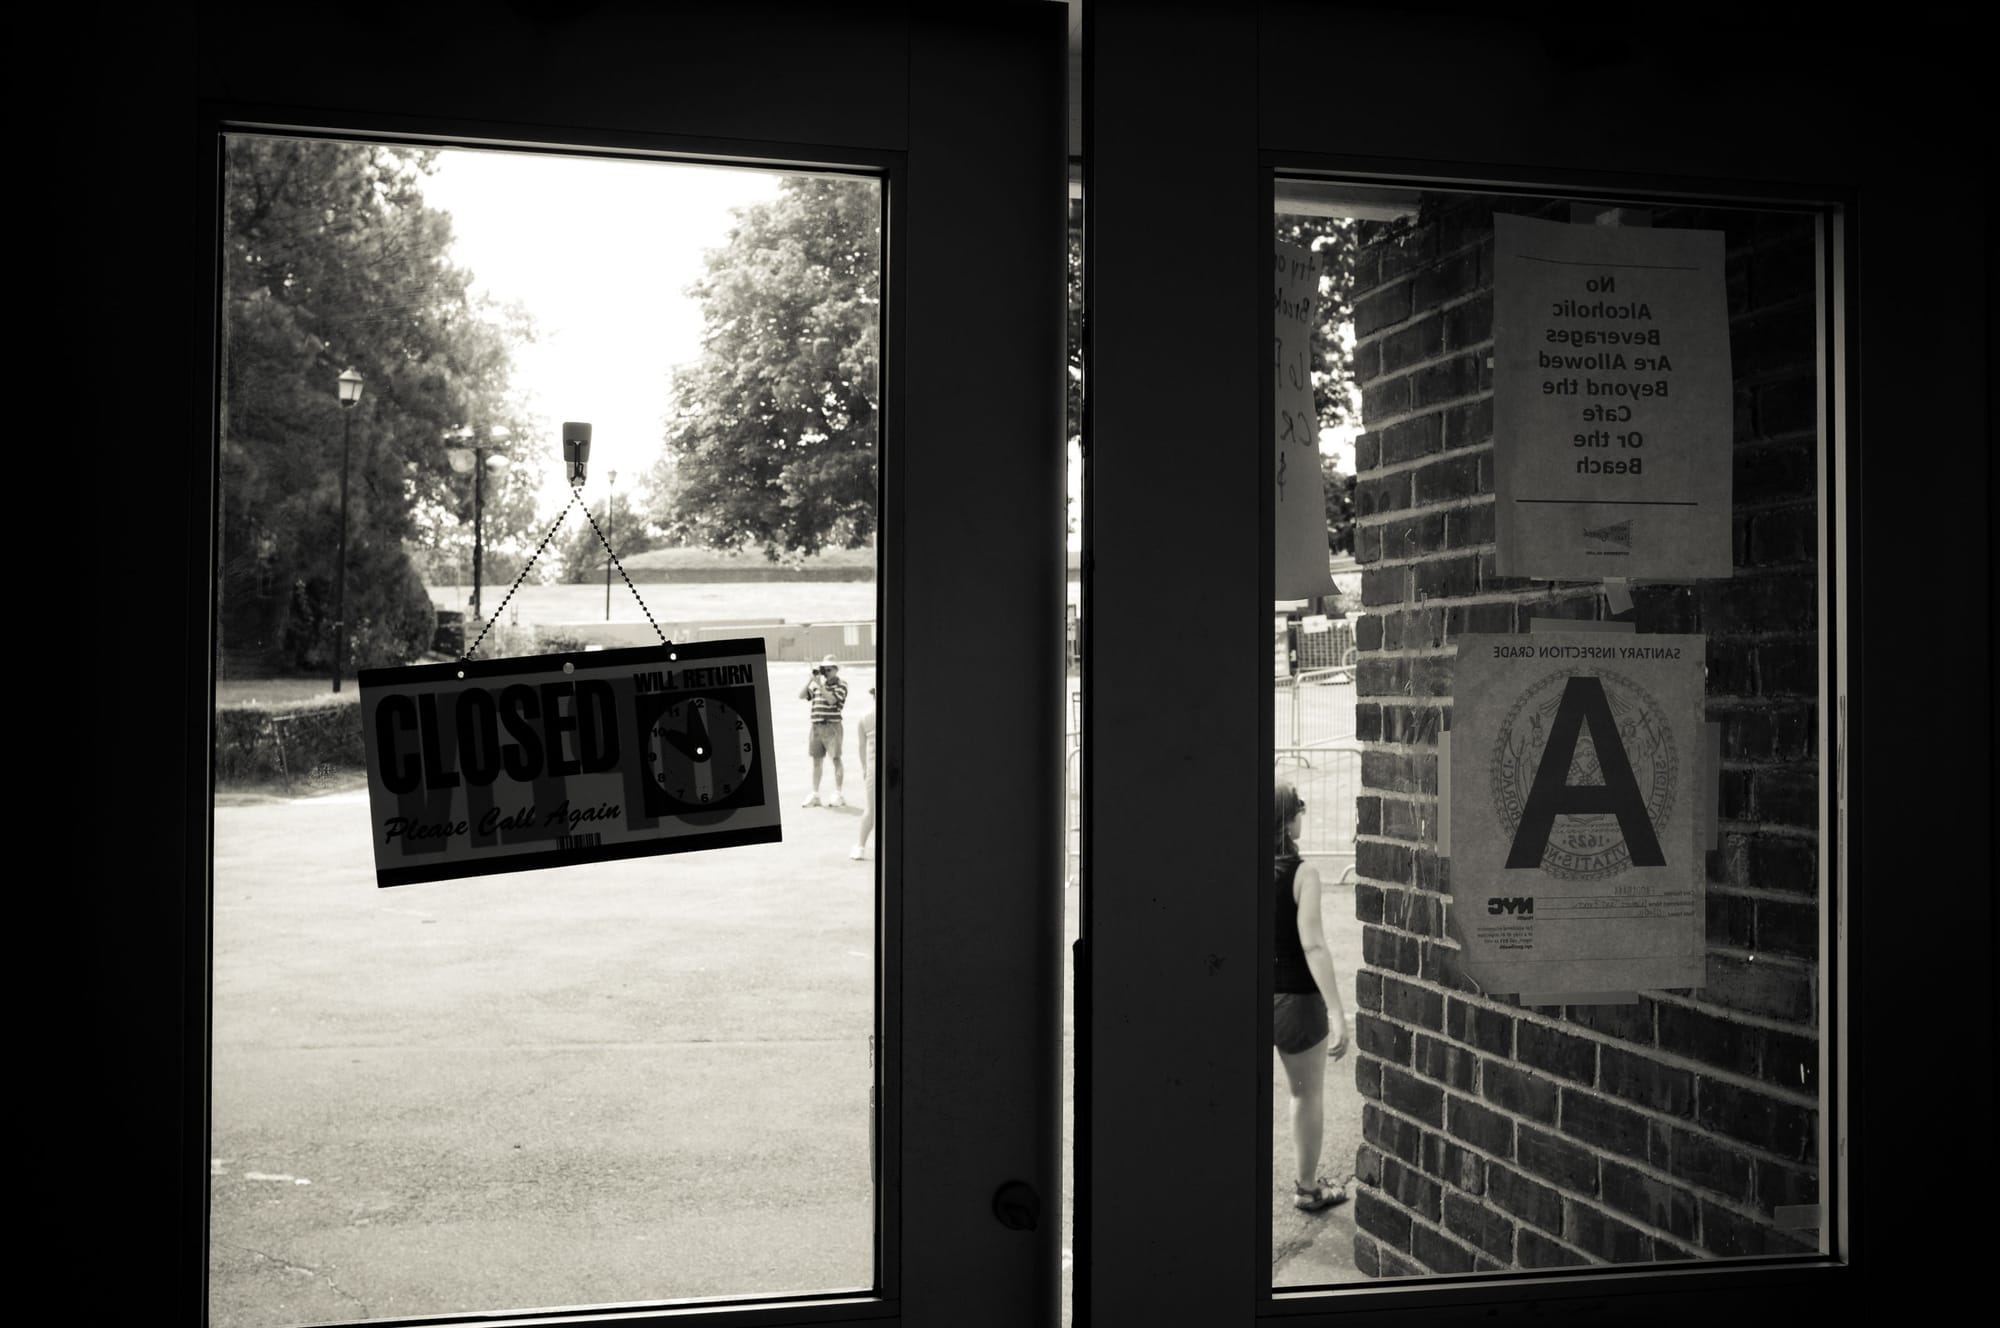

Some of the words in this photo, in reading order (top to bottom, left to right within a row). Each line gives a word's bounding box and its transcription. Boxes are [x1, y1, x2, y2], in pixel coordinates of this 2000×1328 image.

[634, 670, 676, 693] WILL
[683, 663, 753, 688] RETURN
[375, 678, 620, 794] CLOSED
[385, 815, 468, 844] Please
[477, 805, 536, 836] Call
[544, 799, 621, 831] Again
